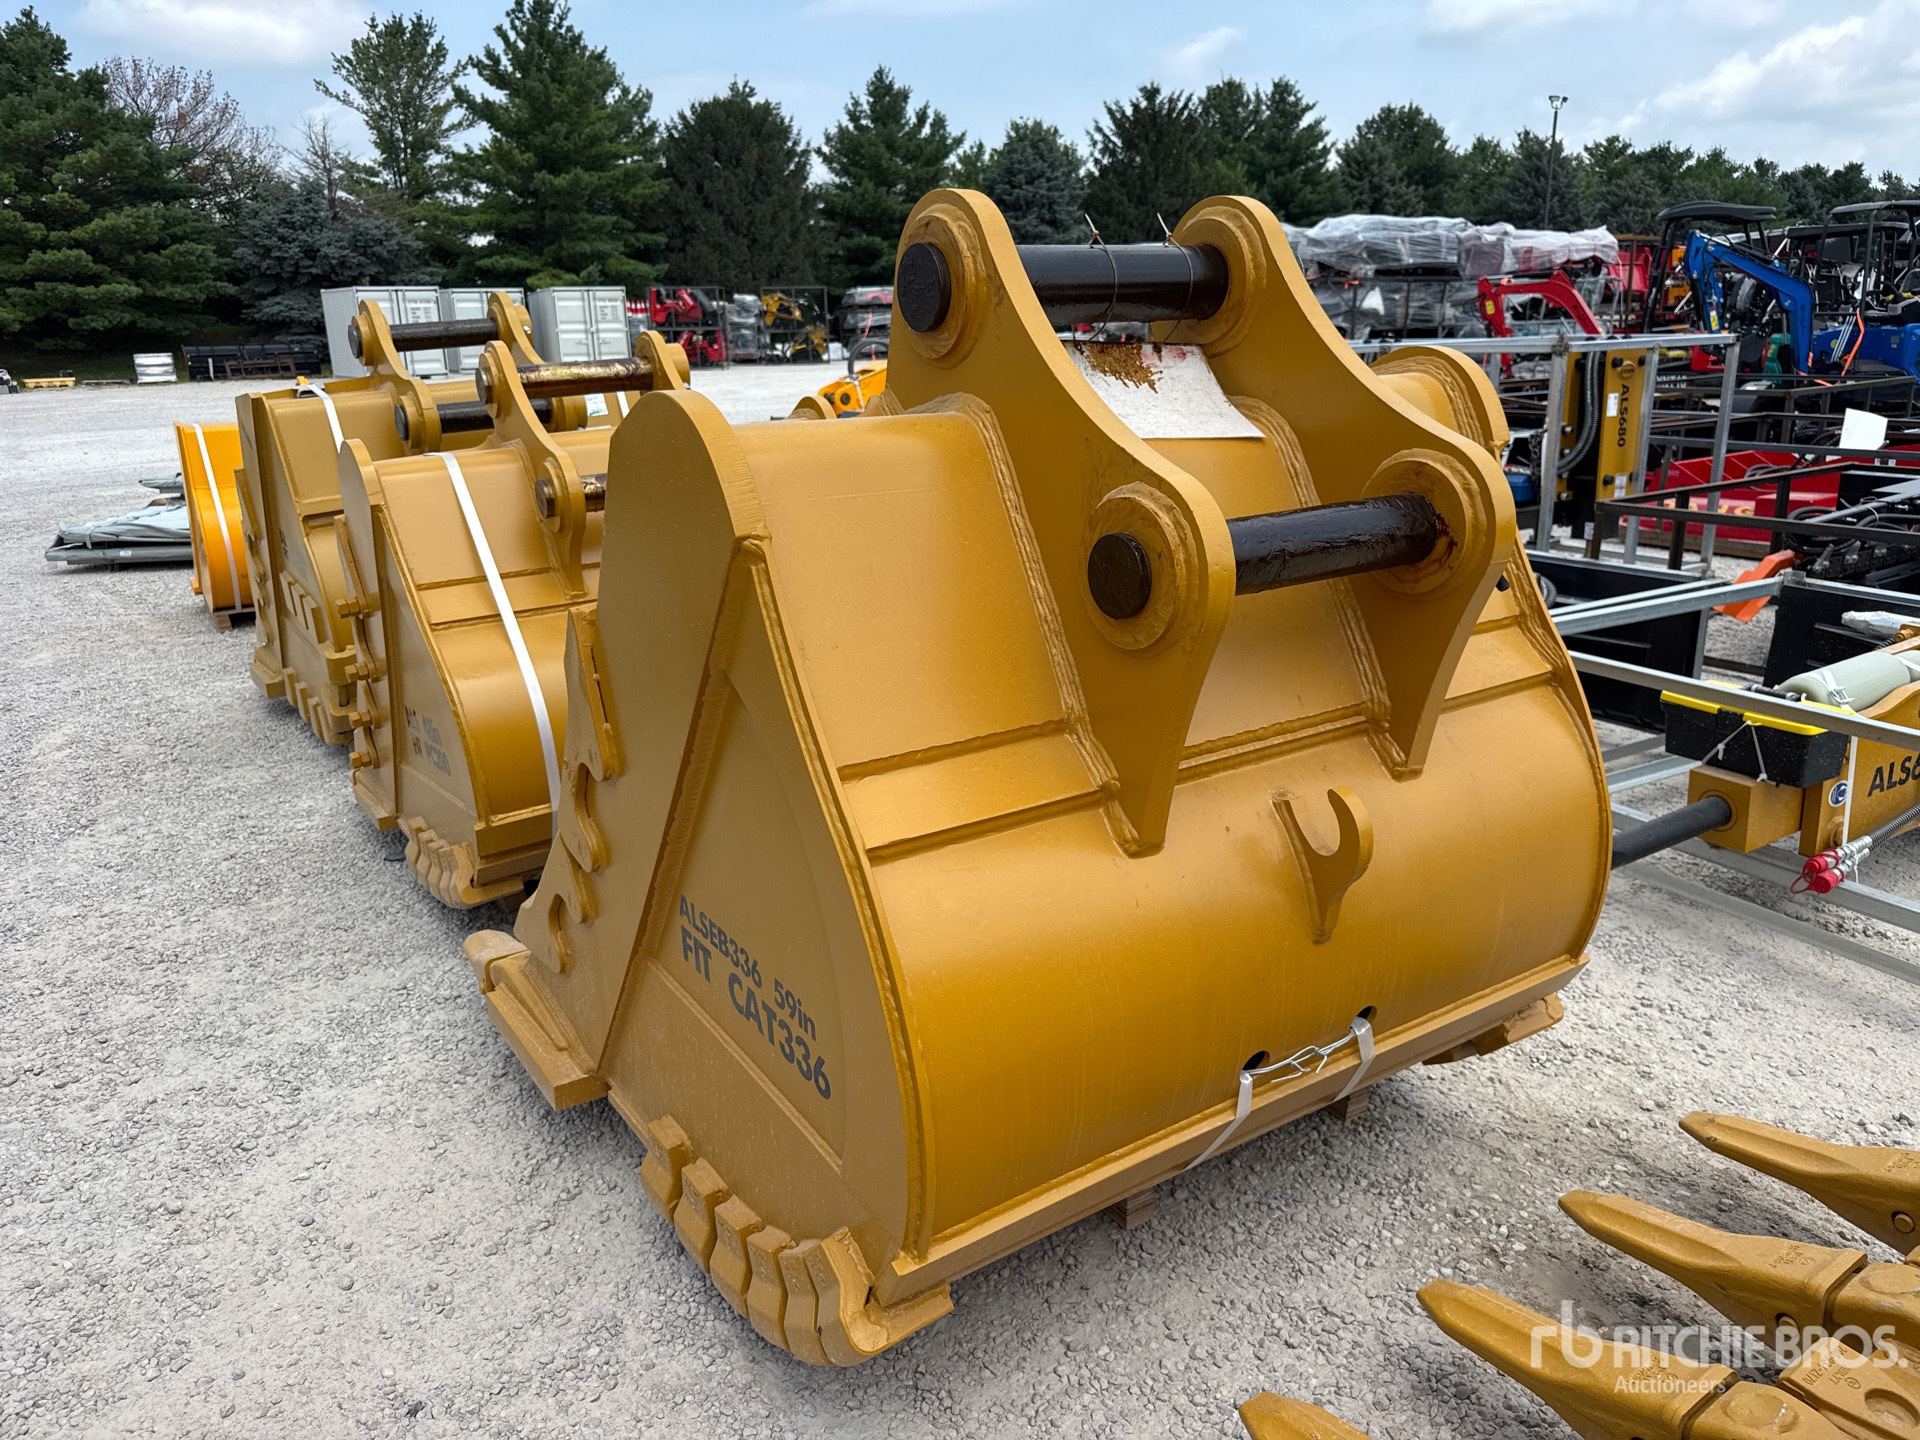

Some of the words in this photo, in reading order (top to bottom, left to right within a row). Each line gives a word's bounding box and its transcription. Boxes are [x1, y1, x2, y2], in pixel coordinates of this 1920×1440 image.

[1616, 383, 1629, 448] ALS680
[680, 894, 762, 988] ALSEB336
[774, 978, 816, 1041] 59in
[681, 925, 712, 983] FIT
[728, 972, 831, 1100] CAT336
